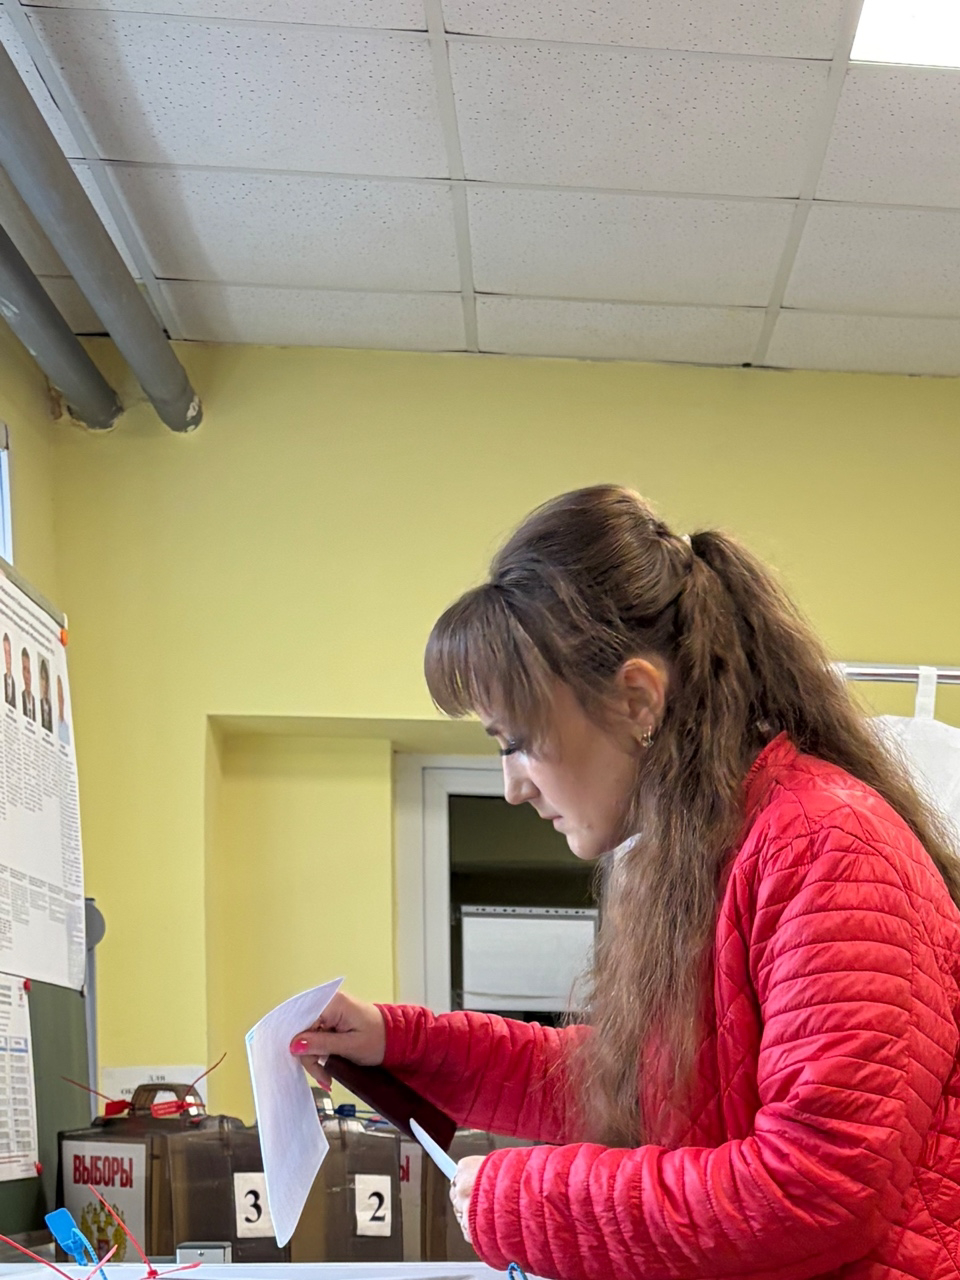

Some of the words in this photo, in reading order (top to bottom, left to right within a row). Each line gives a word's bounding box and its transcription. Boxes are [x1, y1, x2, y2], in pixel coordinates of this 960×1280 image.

[73, 1154, 133, 1189] ВЫБОРЫ
[244, 1189, 262, 1223] 3
[368, 1191, 386, 1222] 2
